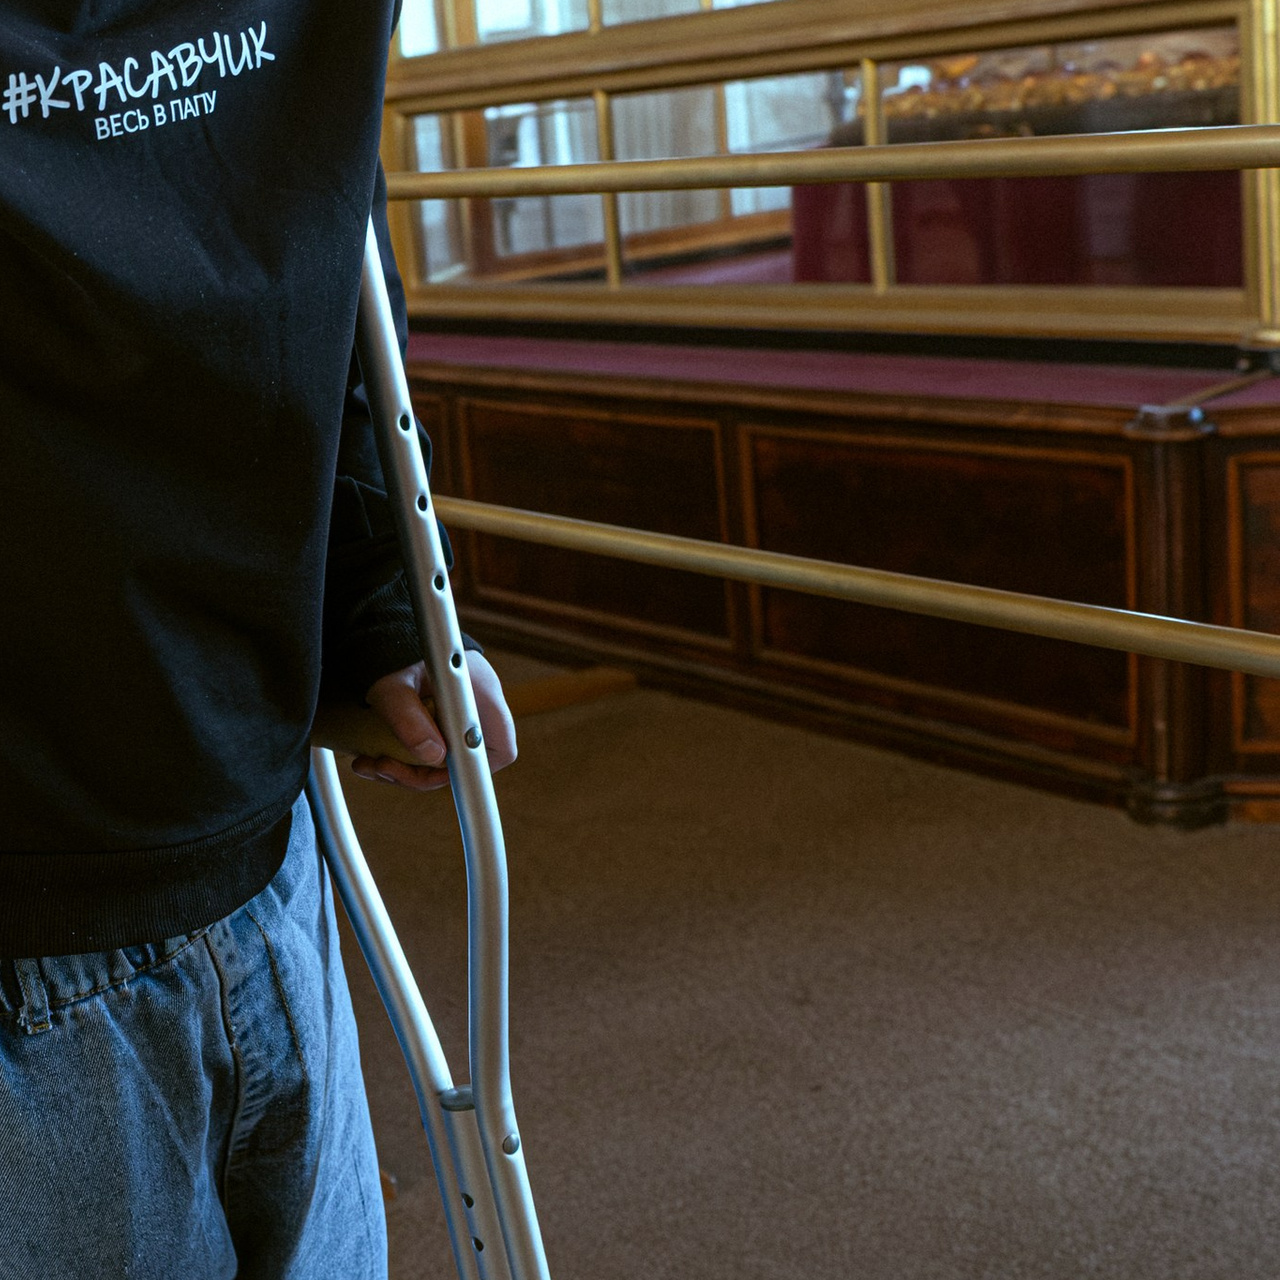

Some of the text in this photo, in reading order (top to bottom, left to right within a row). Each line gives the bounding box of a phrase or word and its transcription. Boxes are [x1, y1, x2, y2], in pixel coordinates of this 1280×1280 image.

[2, 21, 276, 125] #КРАСАВЧИК
[94, 90, 217, 140] ВЕСЬ В ПАПУ
